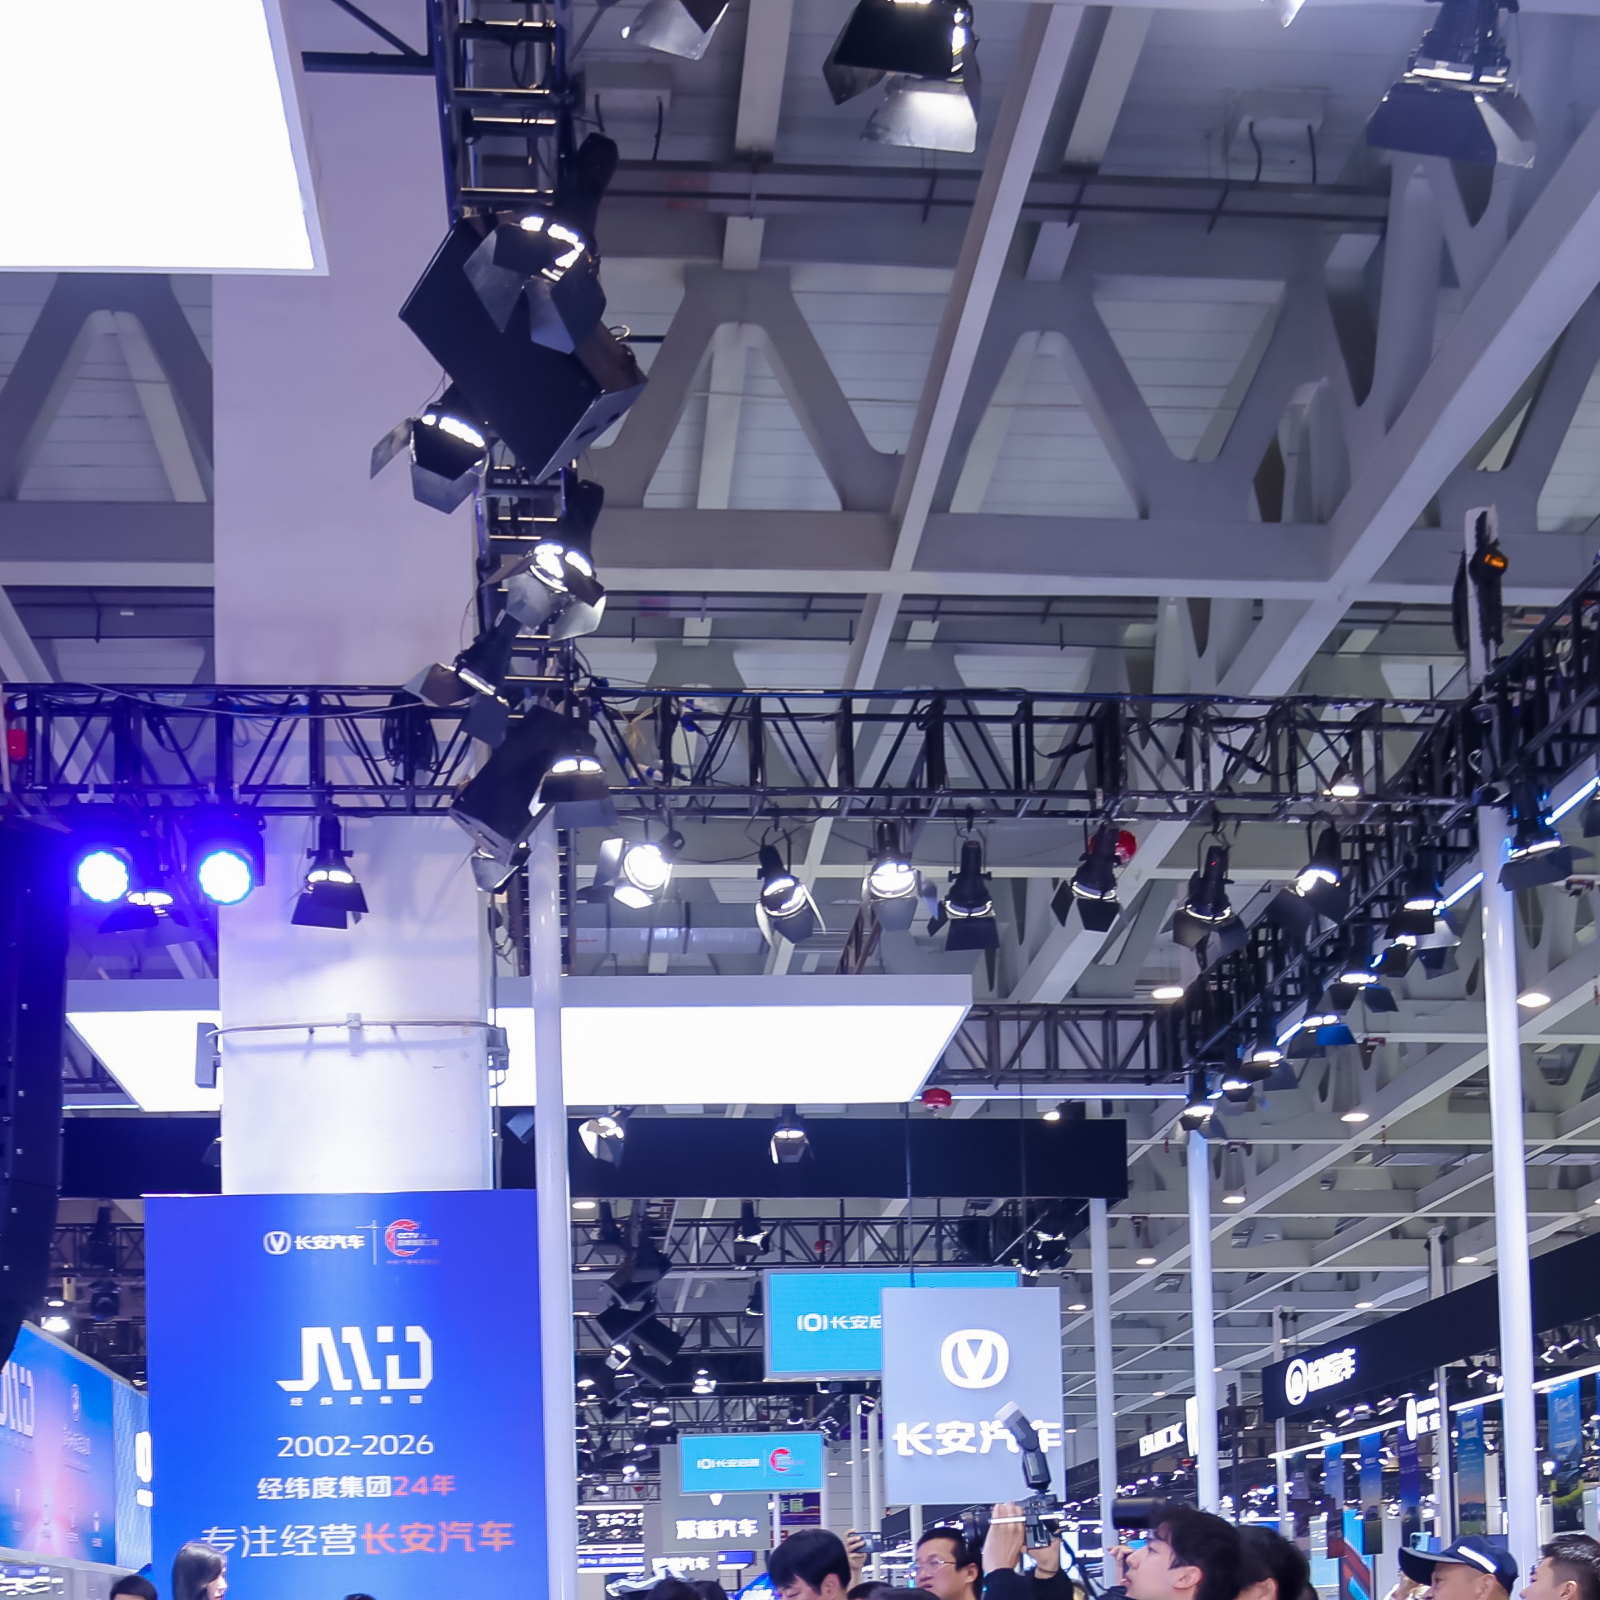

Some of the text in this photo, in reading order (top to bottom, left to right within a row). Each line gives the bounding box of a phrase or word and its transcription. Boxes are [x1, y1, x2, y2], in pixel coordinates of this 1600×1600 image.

[294, 1234, 365, 1250] 长安汽车
[277, 1434, 434, 1458] 2002-2026
[892, 1420, 1062, 1456] 长安汽车
[257, 1474, 457, 1501] 经纬度集团24年
[200, 1521, 516, 1559] 专注经营长安汽车
